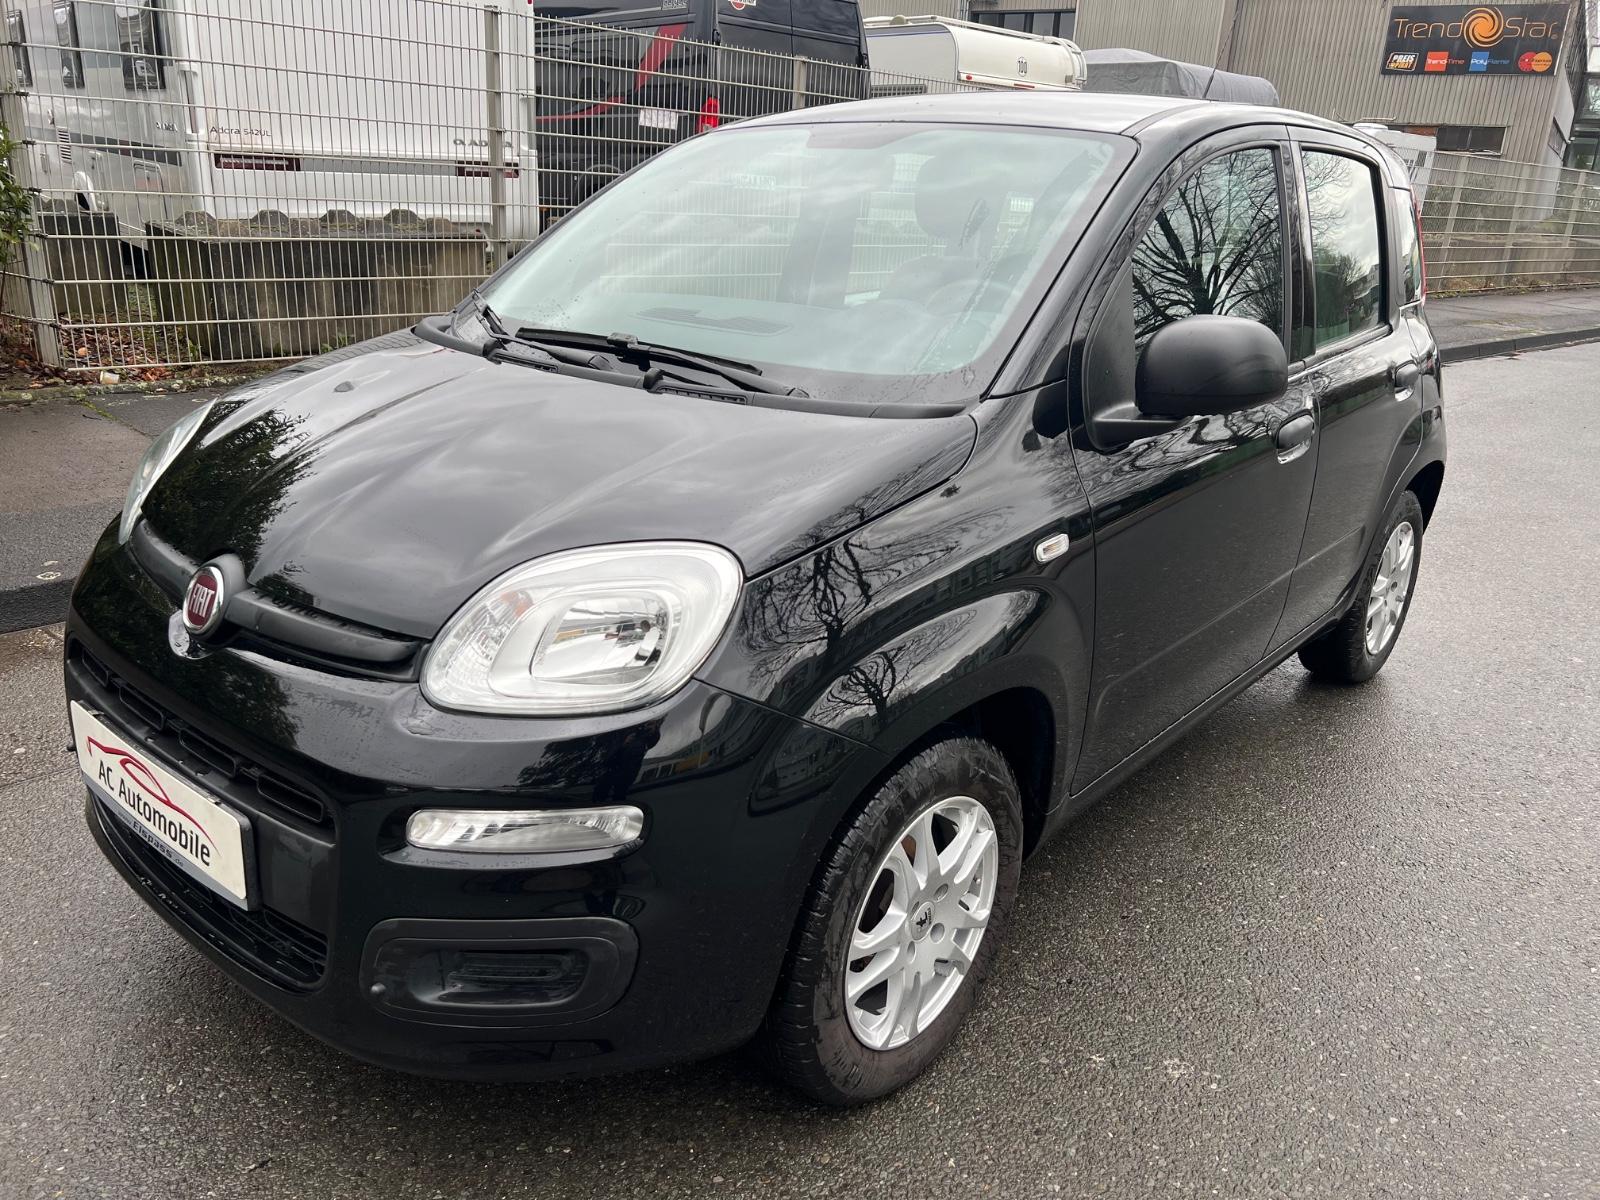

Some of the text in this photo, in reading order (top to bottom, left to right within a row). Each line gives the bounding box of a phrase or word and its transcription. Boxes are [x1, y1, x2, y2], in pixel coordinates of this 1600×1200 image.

[1394, 17, 1558, 39] Trend Star
[189, 583, 215, 618] FIAT
[99, 760, 210, 867] AC Automobile
